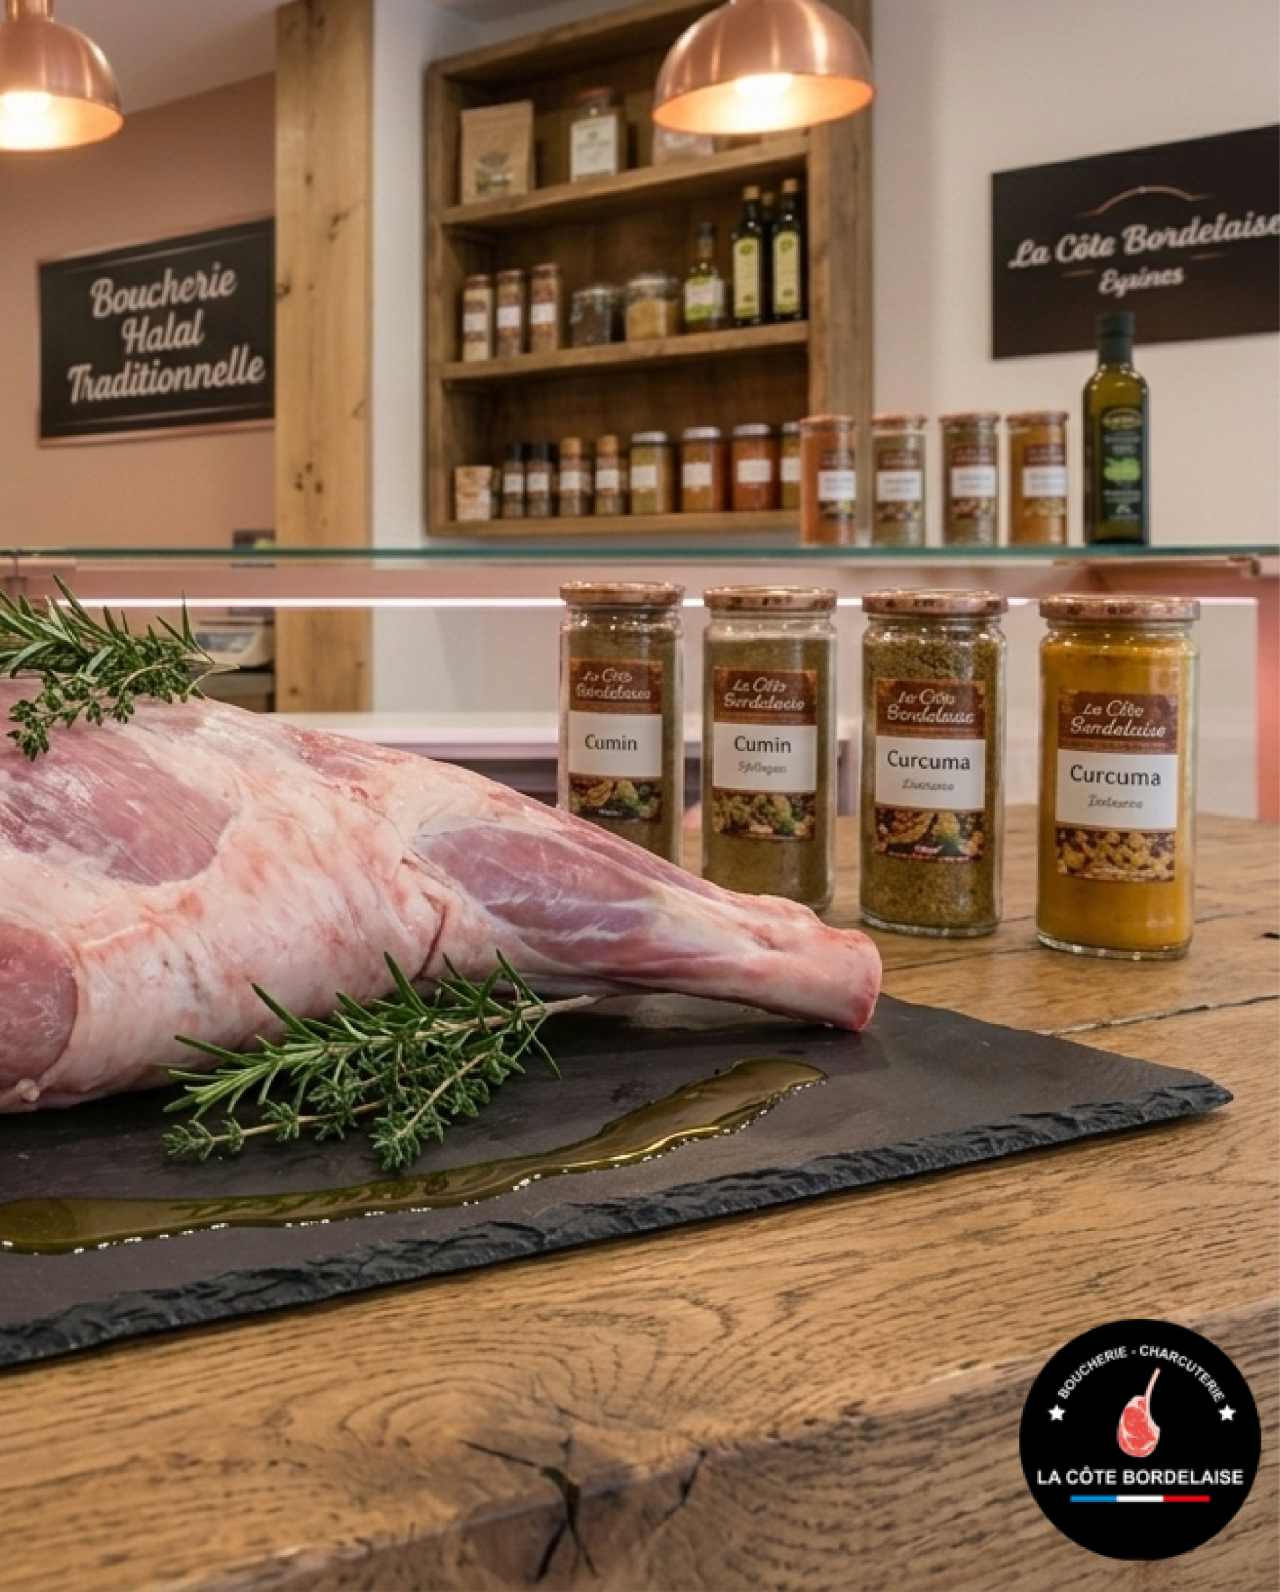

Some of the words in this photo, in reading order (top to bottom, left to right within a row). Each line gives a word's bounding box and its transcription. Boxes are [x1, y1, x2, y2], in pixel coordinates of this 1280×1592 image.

[1008, 239, 1051, 269] La
[1054, 233, 1116, 263] Côte
[1121, 211, 1280, 255] Bordelaise
[90, 262, 236, 318] Boucherie
[121, 308, 205, 354] Halal
[67, 343, 266, 404] Traditionnelle
[584, 733, 638, 751] Cumin
[734, 735, 792, 754] Cumin
[887, 749, 971, 771] Curcuma
[1070, 764, 1161, 787] Curcuma
